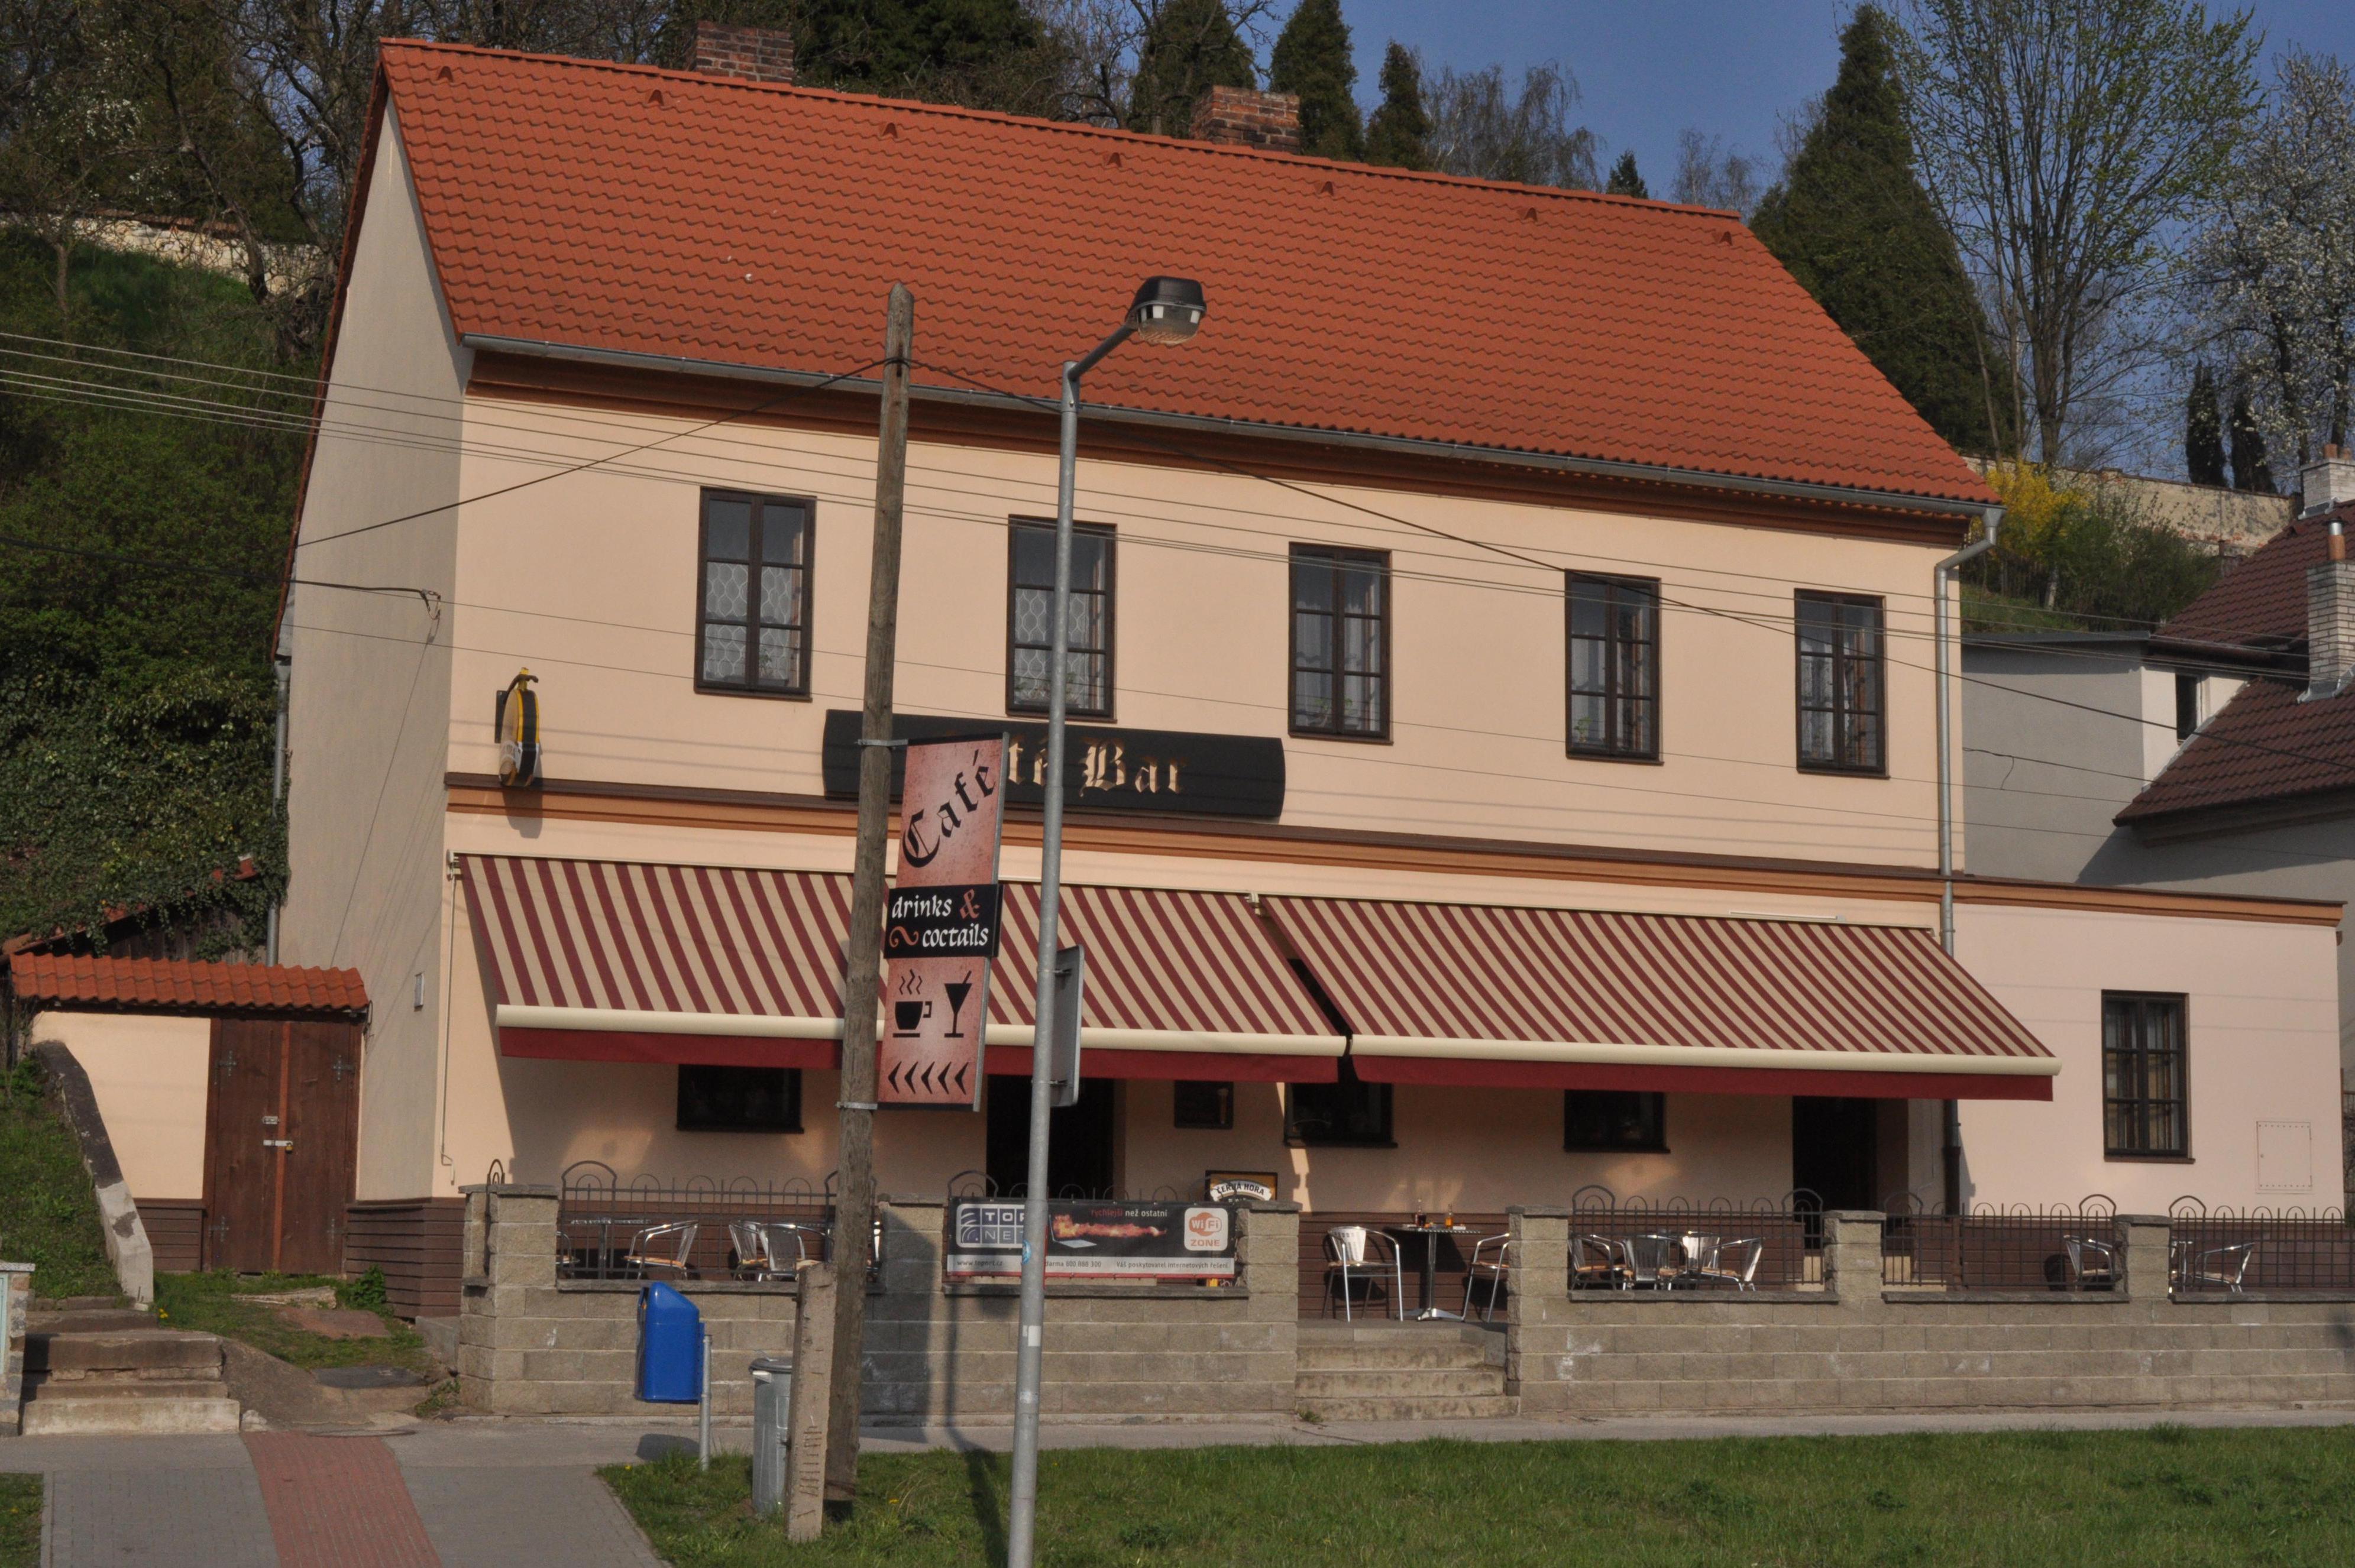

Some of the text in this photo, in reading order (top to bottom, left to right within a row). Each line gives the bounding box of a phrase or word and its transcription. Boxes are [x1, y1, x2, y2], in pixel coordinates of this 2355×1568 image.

[1079, 739, 1185, 797] Bar
[902, 749, 996, 868] Café
[891, 889, 981, 919] drinks &
[922, 922, 989, 948] coctails
[1244, 1184, 1264, 1196] HORA
[1125, 1209, 1138, 1217] než
[1141, 1209, 1167, 1217] ostatní
